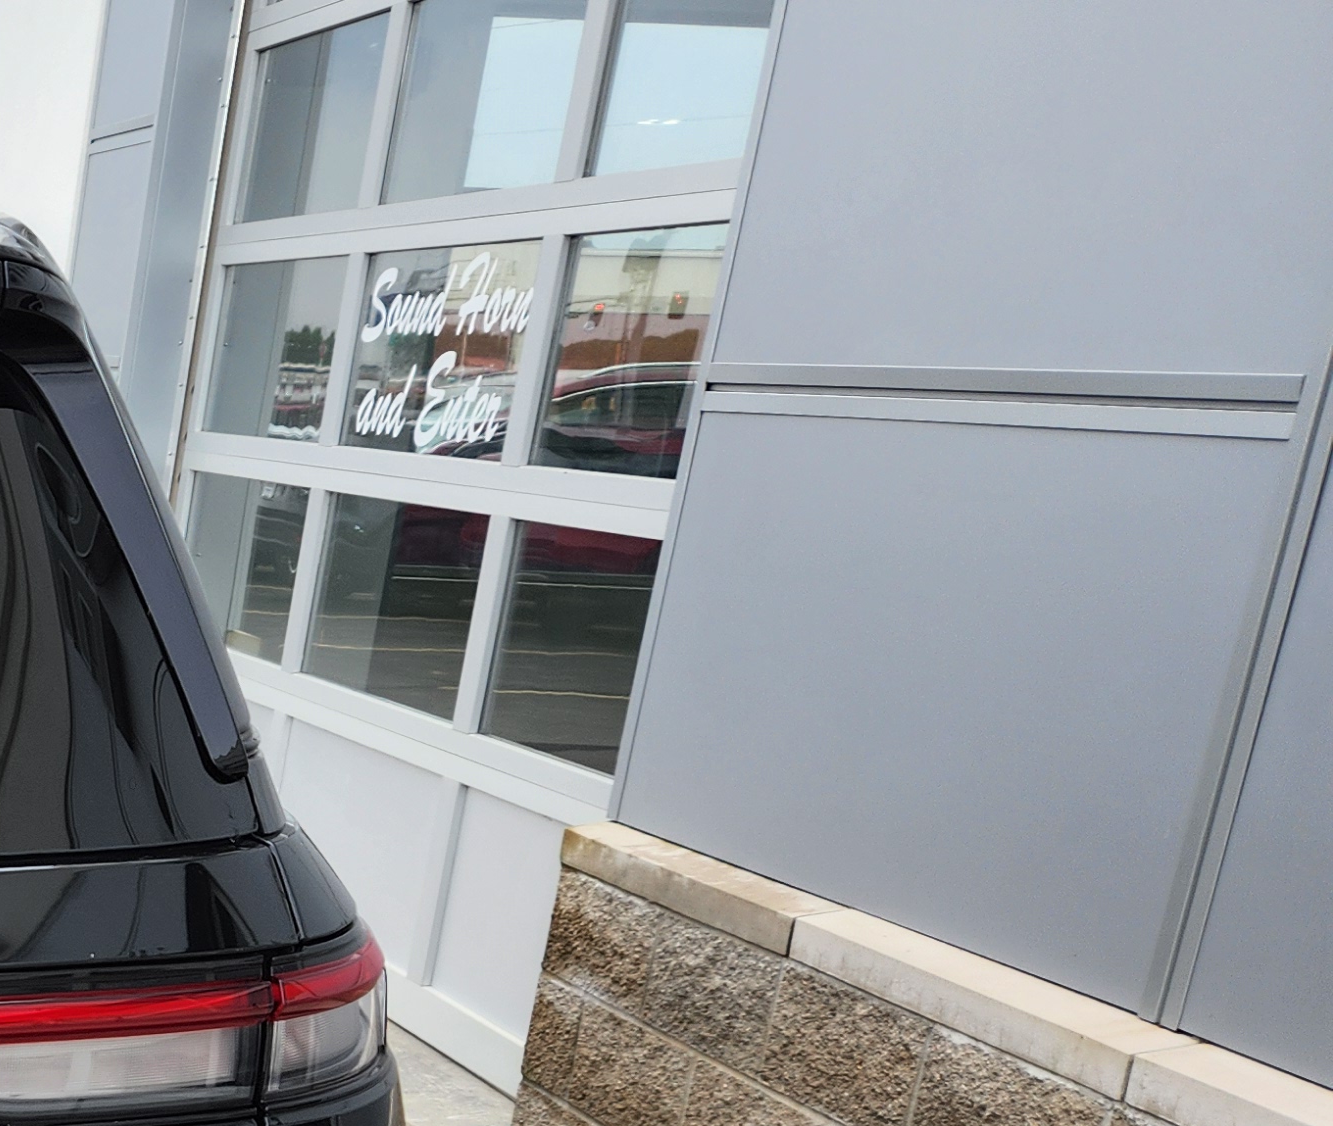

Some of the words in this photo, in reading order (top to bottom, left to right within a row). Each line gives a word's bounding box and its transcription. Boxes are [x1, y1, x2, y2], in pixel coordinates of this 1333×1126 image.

[361, 264, 457, 342] Sound
[455, 252, 534, 336] Horn
[355, 364, 417, 438] and
[413, 351, 501, 447] Enter
